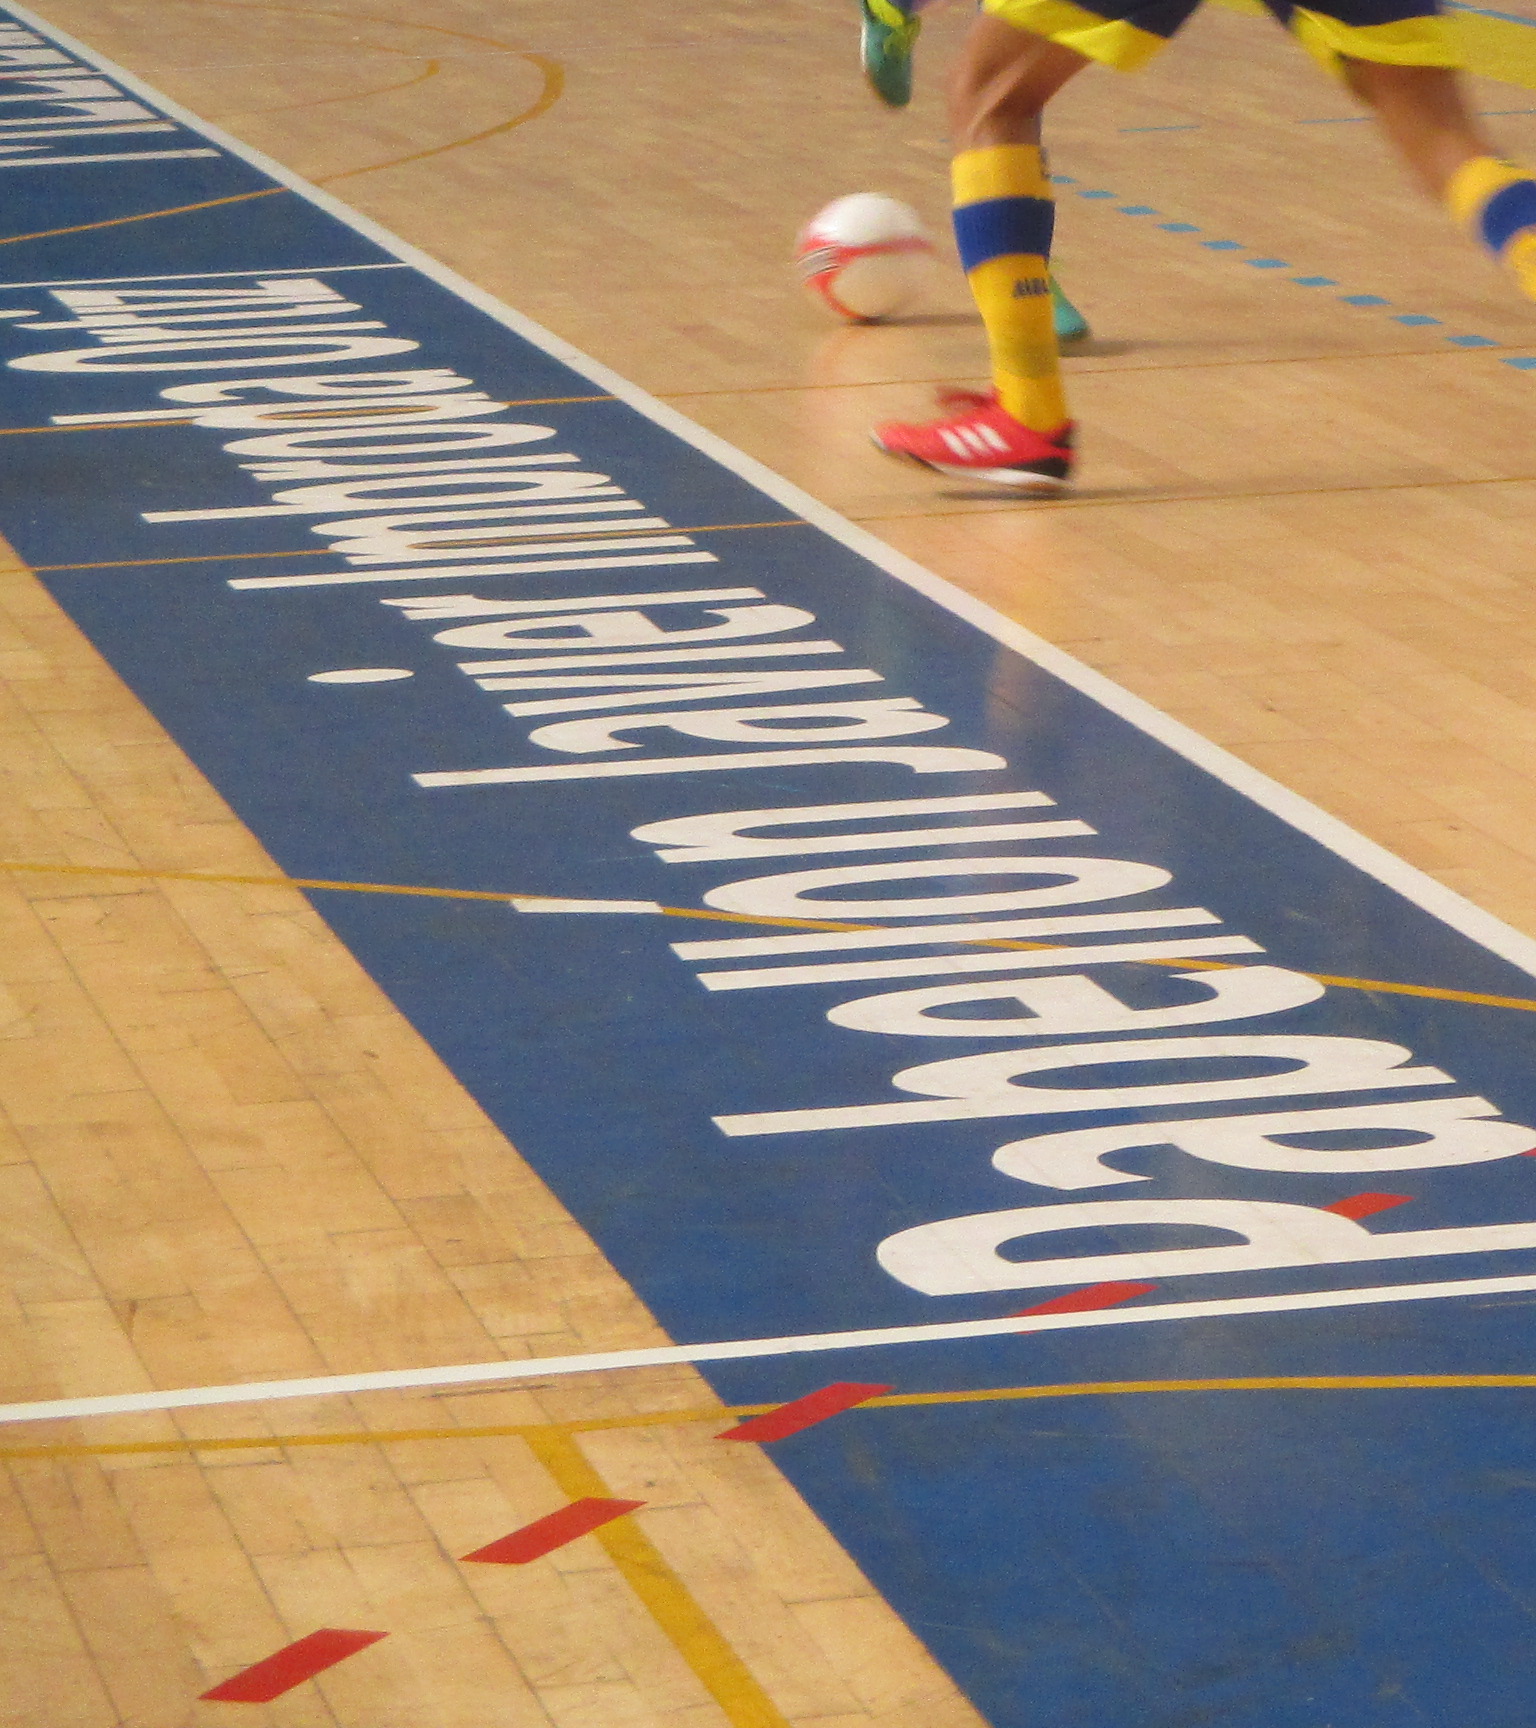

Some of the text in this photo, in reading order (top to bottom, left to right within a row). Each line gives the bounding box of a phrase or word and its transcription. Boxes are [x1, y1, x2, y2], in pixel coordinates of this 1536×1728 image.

[0, 277, 421, 373] Ortiz
[51, 368, 718, 590] Imbroda
[306, 586, 1007, 789] Javier
